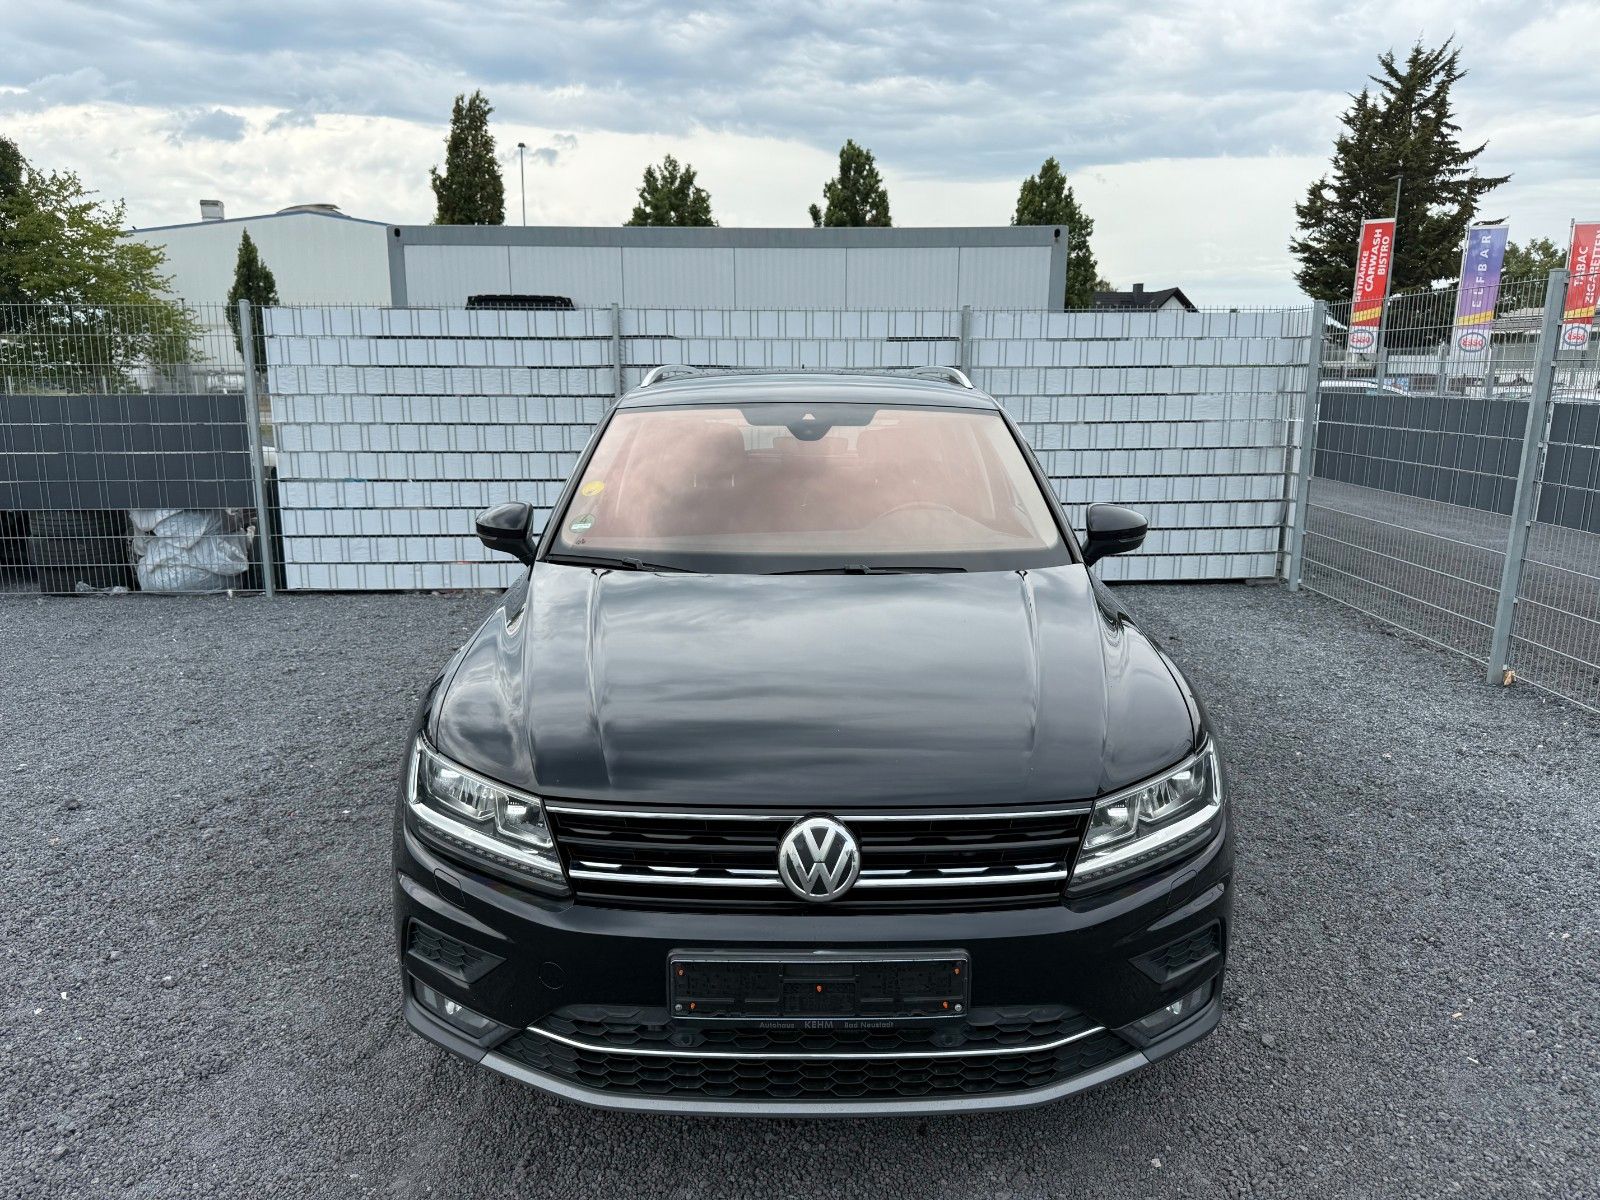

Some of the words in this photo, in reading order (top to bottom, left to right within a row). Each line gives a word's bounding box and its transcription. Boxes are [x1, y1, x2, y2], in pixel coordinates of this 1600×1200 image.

[1364, 229, 1382, 292] CARWASH
[1377, 236, 1390, 275] BISTRO
[1573, 246, 1589, 287] TABAC
[759, 1021, 795, 1029] Autohaus
[804, 1020, 834, 1029] KEHM
[844, 1021, 858, 1029] Bad
[860, 1021, 894, 1029] Neustadt
